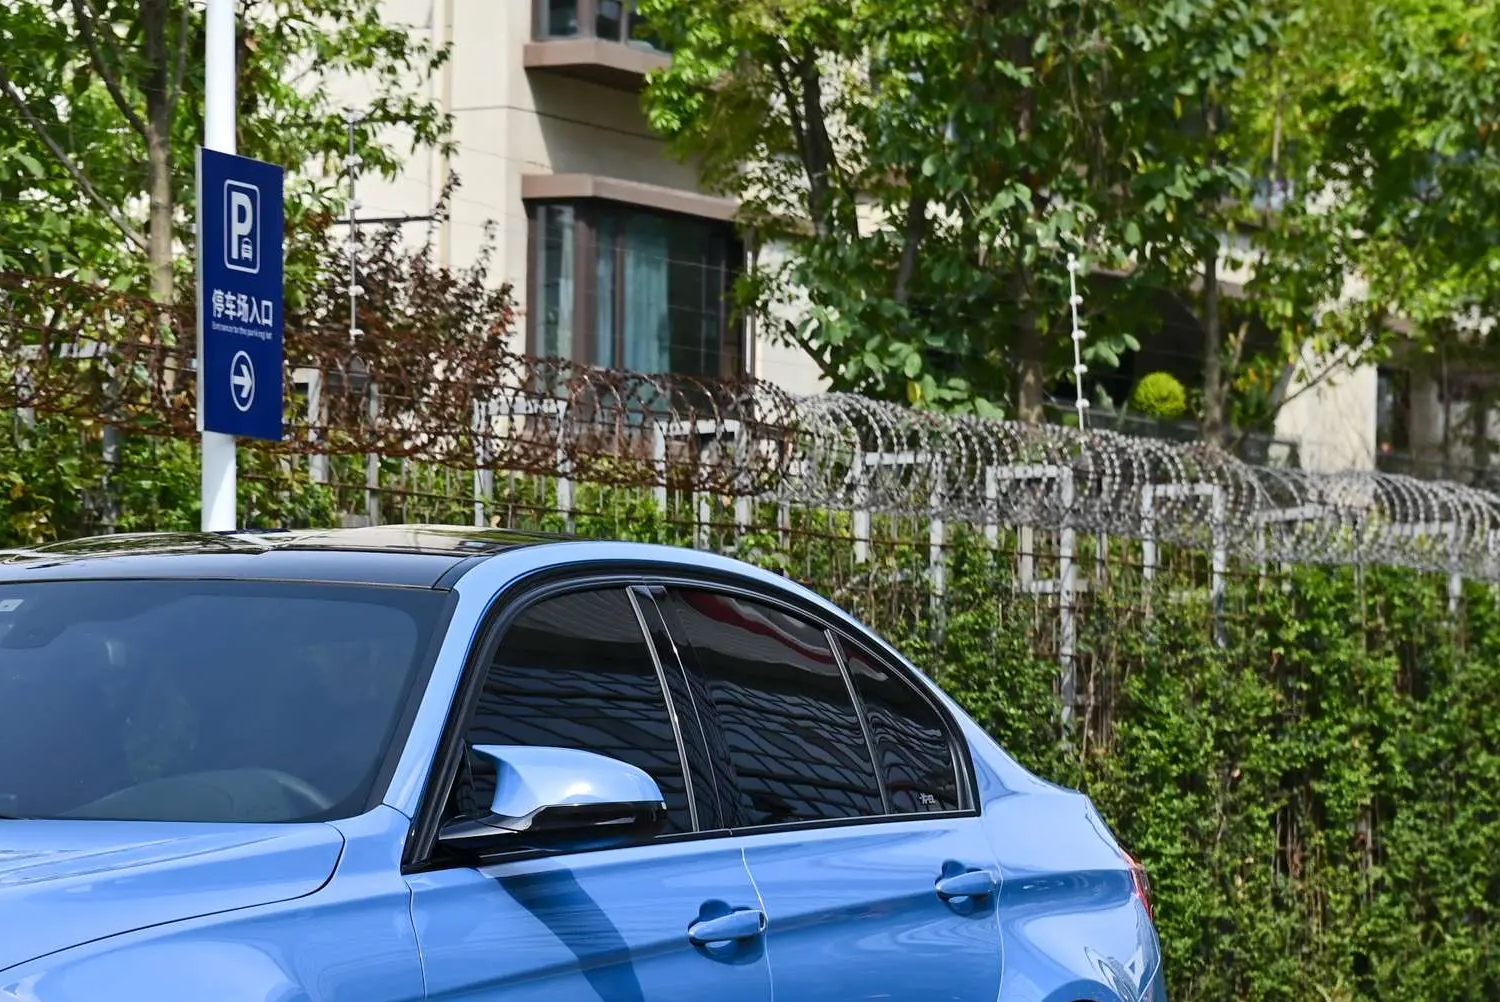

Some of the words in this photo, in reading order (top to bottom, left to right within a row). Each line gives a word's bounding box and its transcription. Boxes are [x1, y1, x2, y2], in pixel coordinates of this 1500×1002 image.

[231, 191, 253, 260] P
[212, 288, 273, 327] 停车场入口
